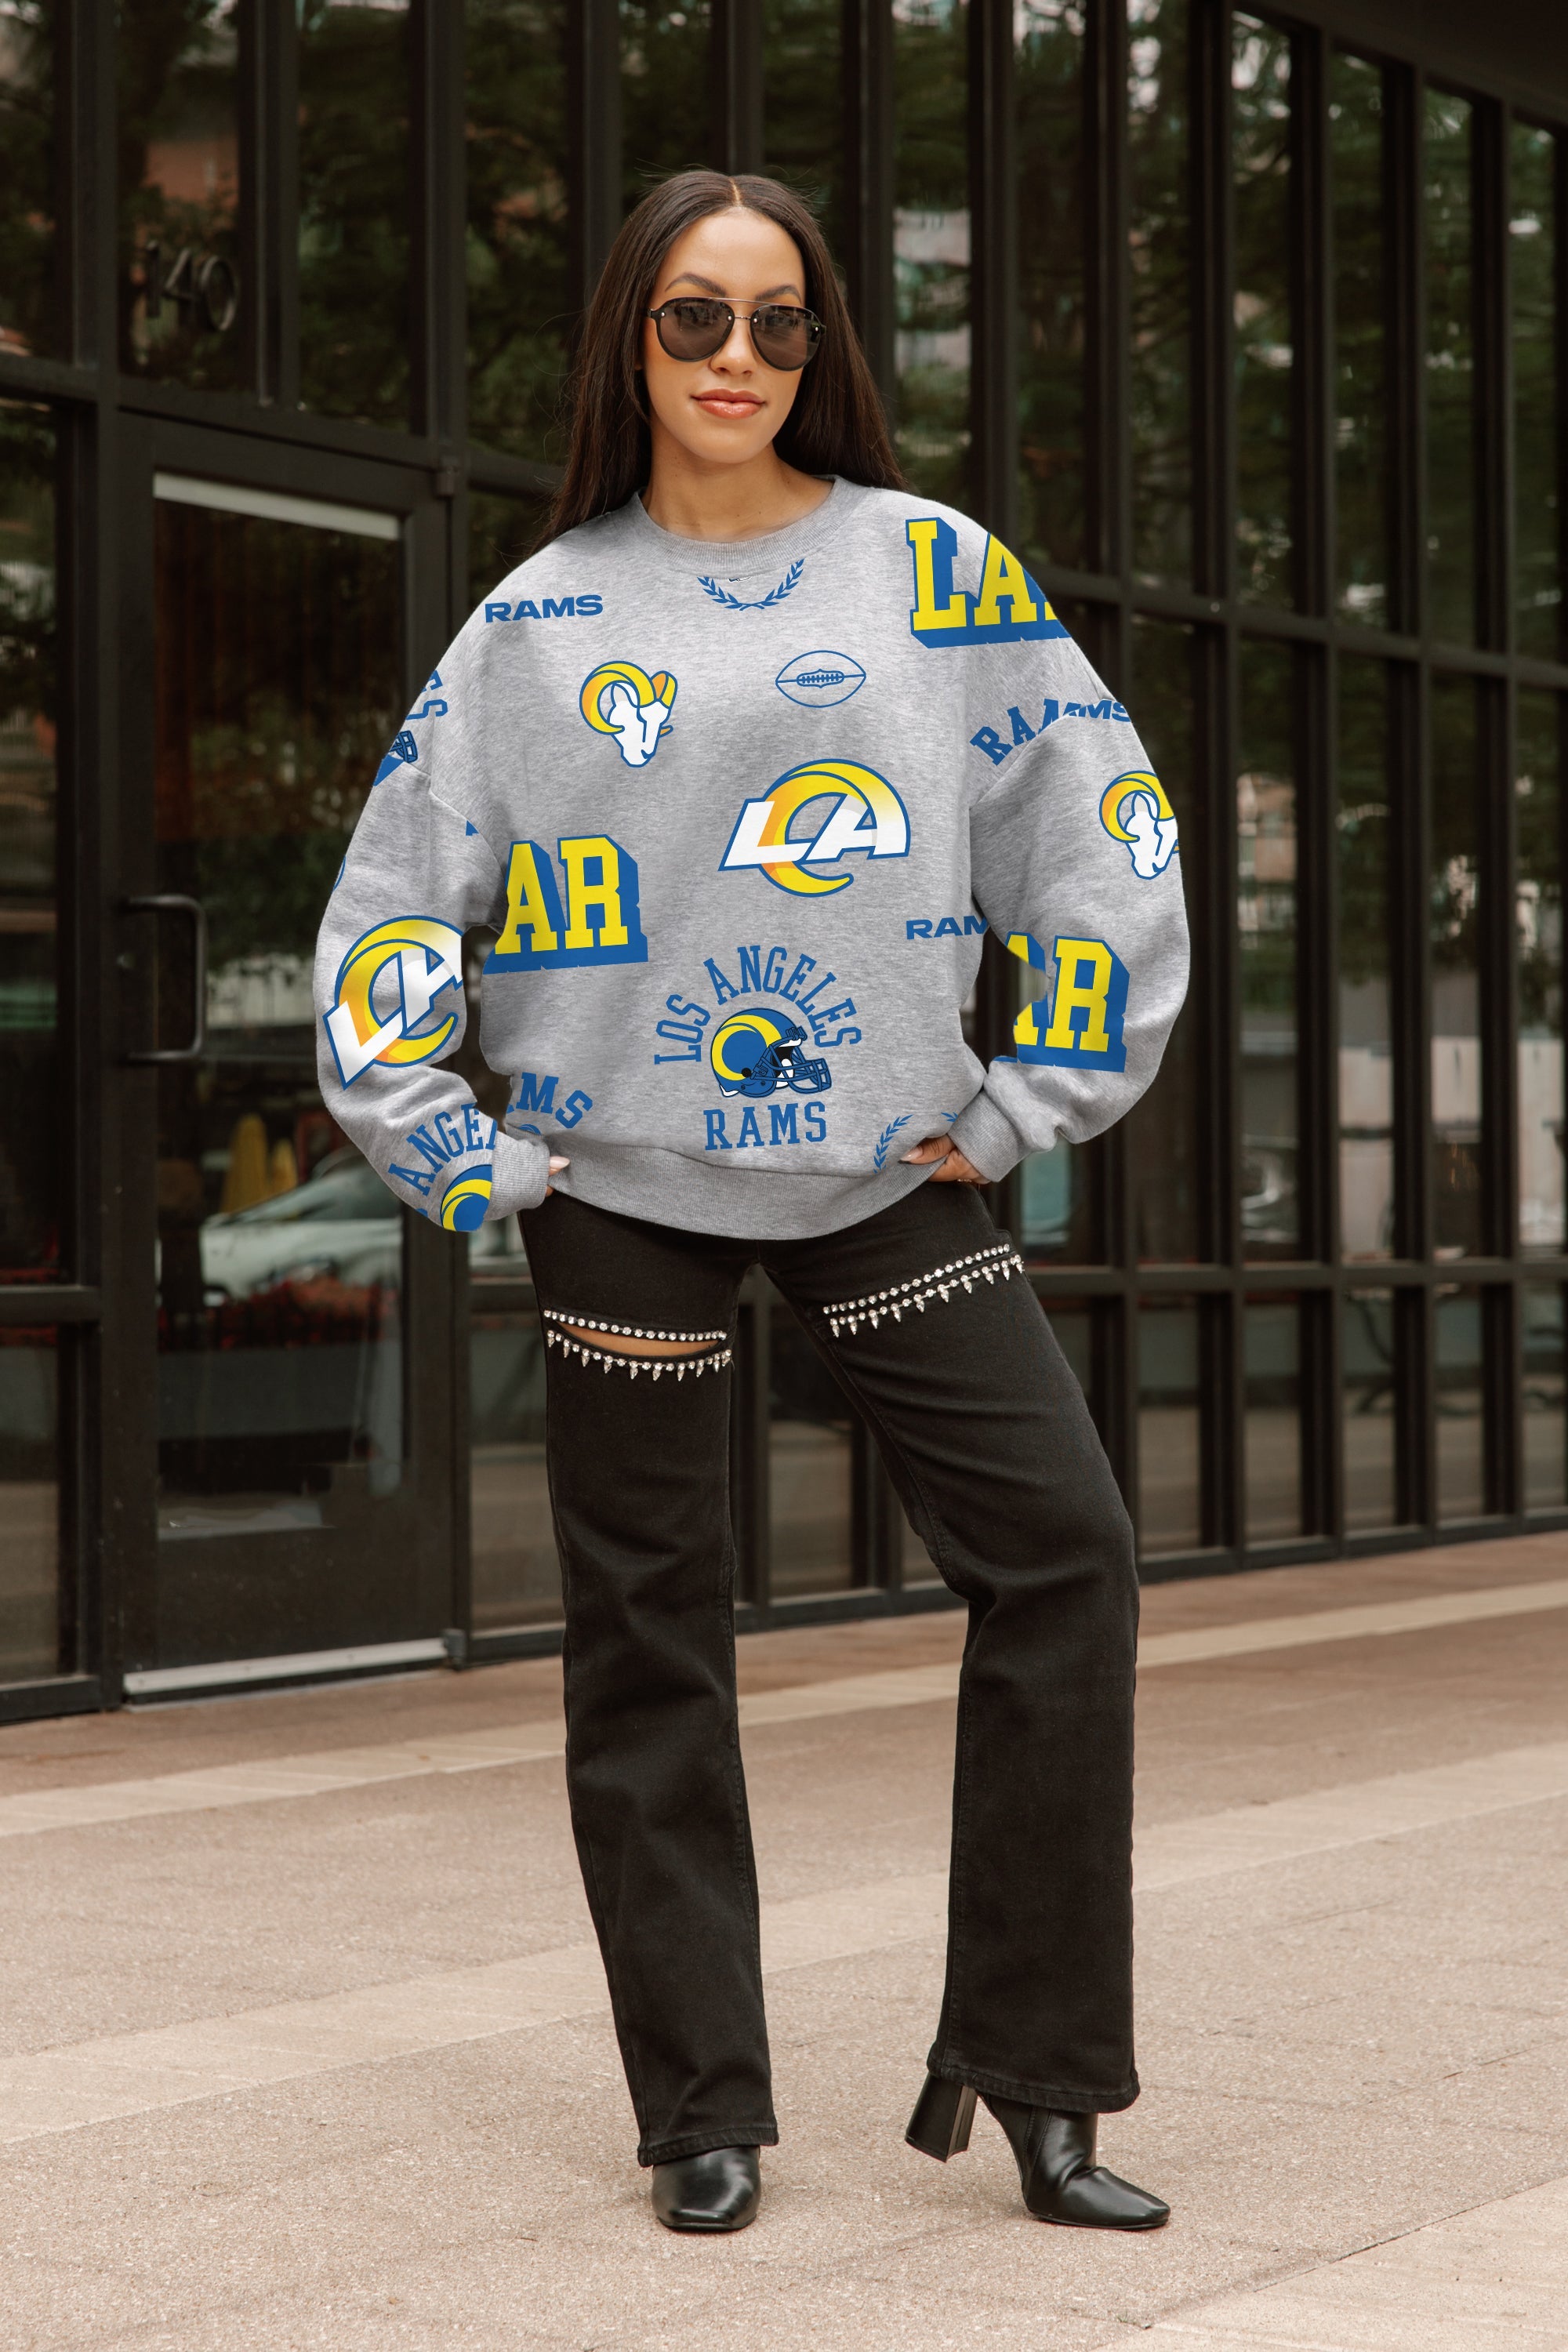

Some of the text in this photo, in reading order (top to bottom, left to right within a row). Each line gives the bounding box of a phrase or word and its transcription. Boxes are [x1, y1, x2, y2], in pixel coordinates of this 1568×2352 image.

[145, 239, 239, 332] 140
[485, 594, 603, 623] RAMS
[906, 517, 1072, 648] LA
[654, 945, 862, 1065] LOS ANGELES
[506, 1072, 593, 1129] MS
[703, 1101, 826, 1151] RAMS
